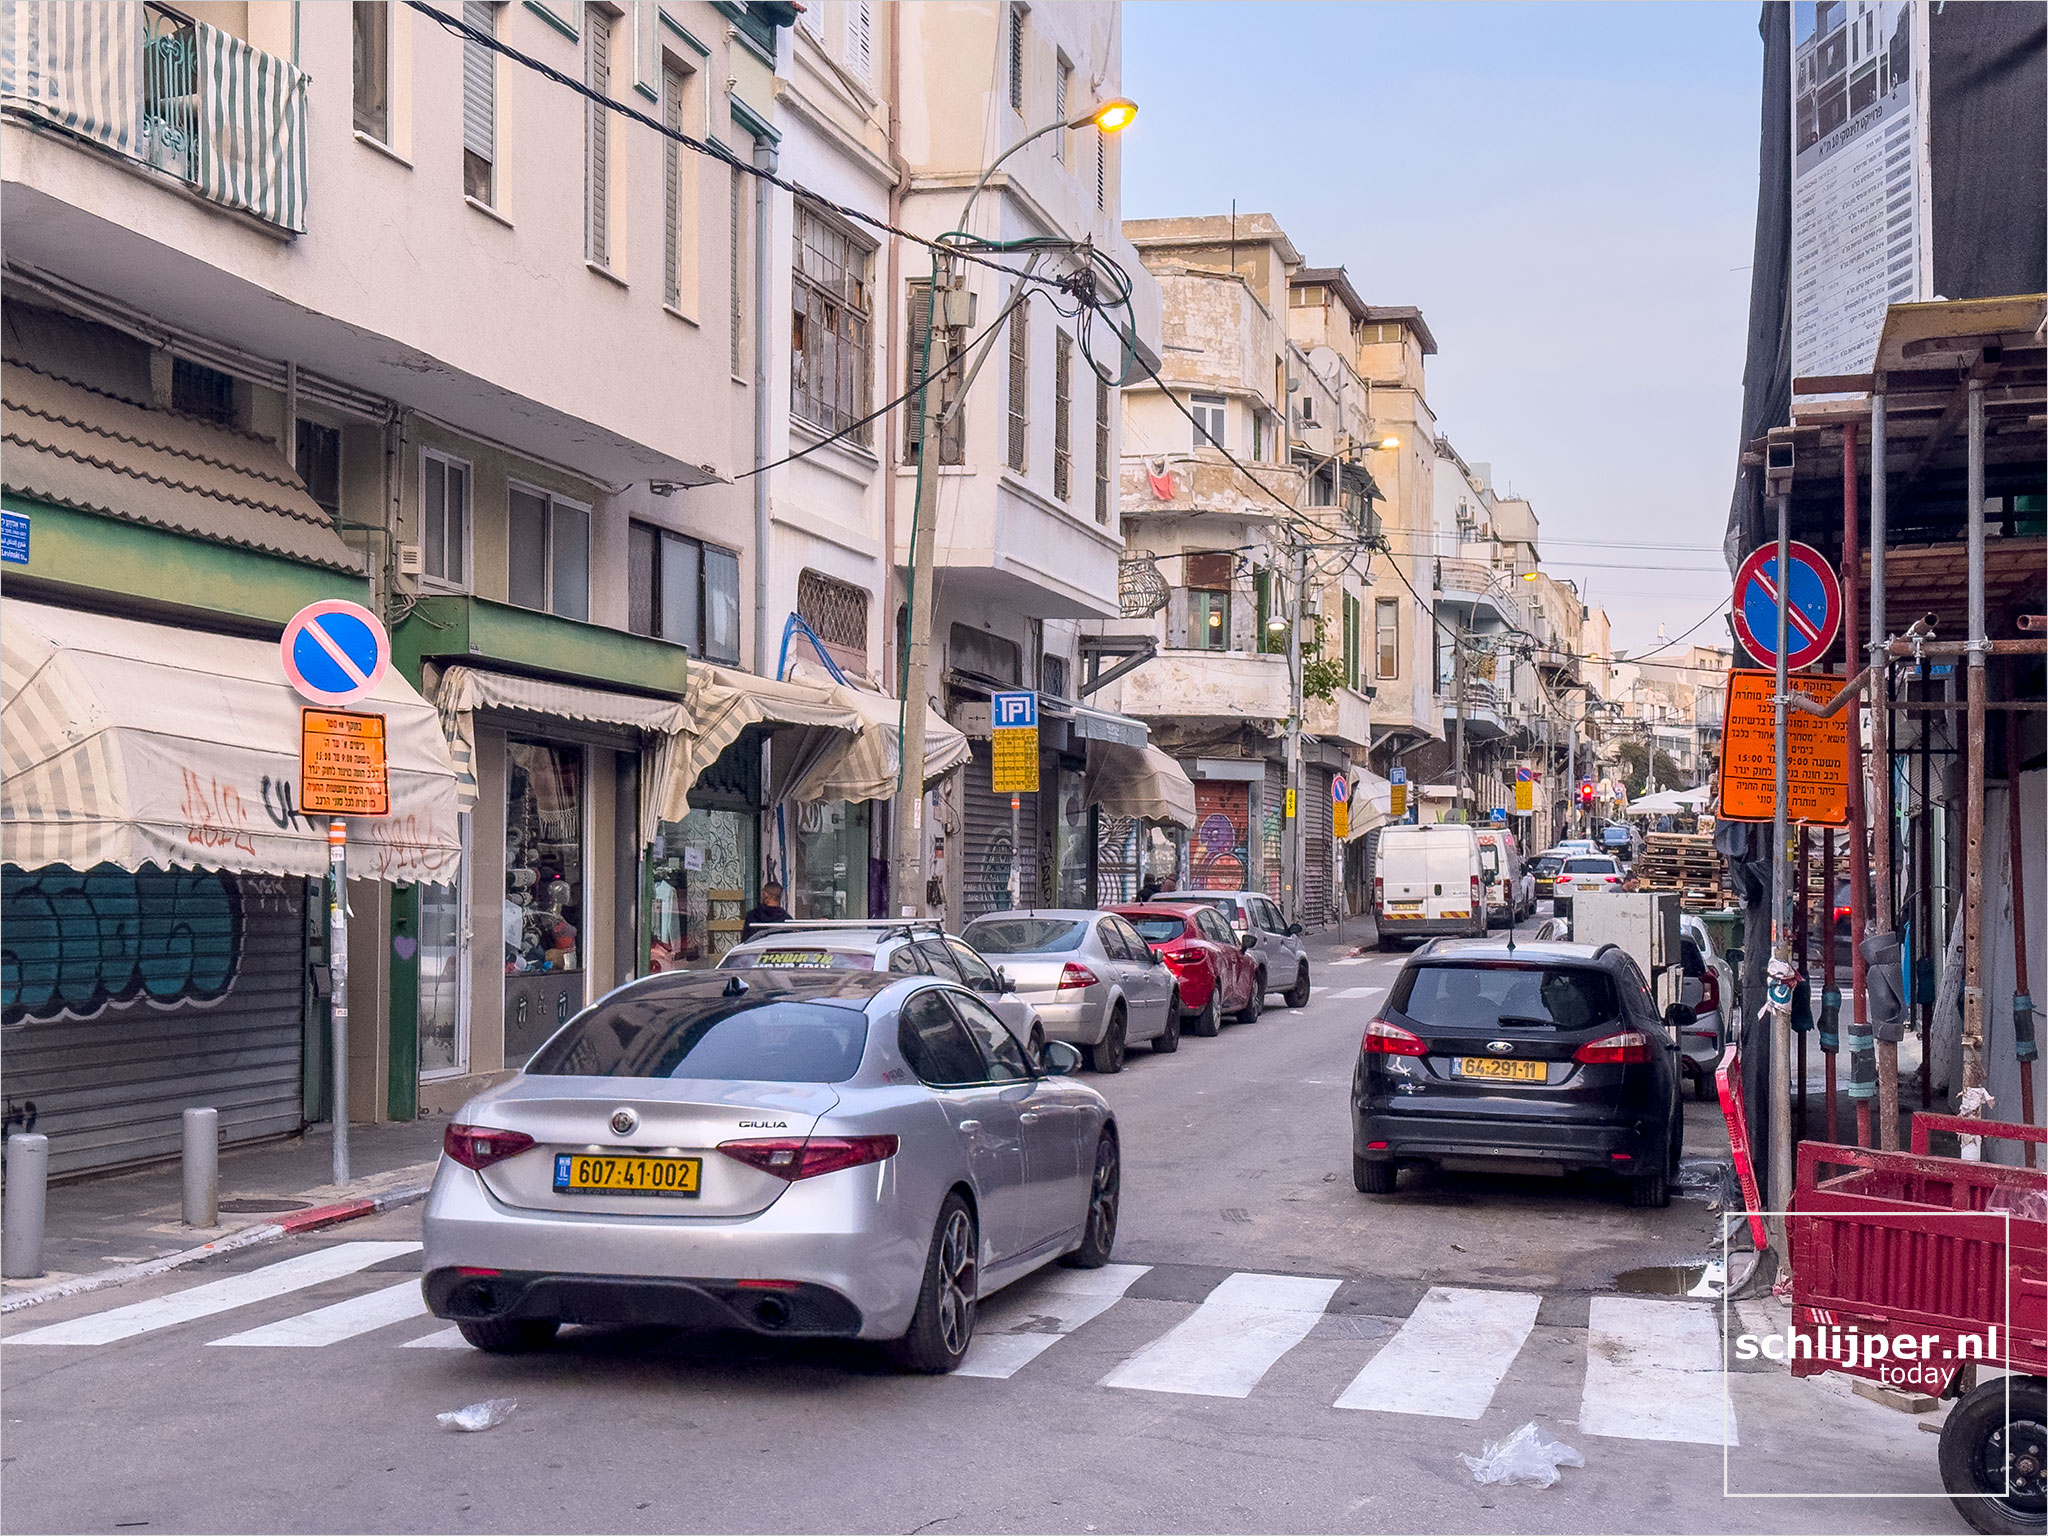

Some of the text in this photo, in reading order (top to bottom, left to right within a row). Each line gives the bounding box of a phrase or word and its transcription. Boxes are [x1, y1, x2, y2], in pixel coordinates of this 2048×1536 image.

[1789, 680, 1799, 690] 16
[1804, 682, 1832, 692] בתוקף
[1735, 691, 1762, 701] מותרת
[1732, 716, 1766, 726] ברשיונם
[1812, 720, 1829, 729] רכב
[1731, 728, 1749, 738] בלבד
[1791, 746, 1814, 755] בימים
[1738, 754, 1763, 764] 15:00
[1812, 758, 1841, 768] משעה
[1753, 767, 1772, 777] לחוק
[1802, 770, 1821, 779] חונה
[1824, 771, 1839, 780] רכב
[1736, 781, 1758, 791] החניה
[1792, 785, 1815, 795] הימים
[1818, 787, 1835, 796] ביתר
[1757, 795, 1772, 804] סוגי
[1792, 798, 1817, 807] מותרת
[738, 1120, 788, 1129] GIULIA
[559, 1166, 568, 1178] IL
